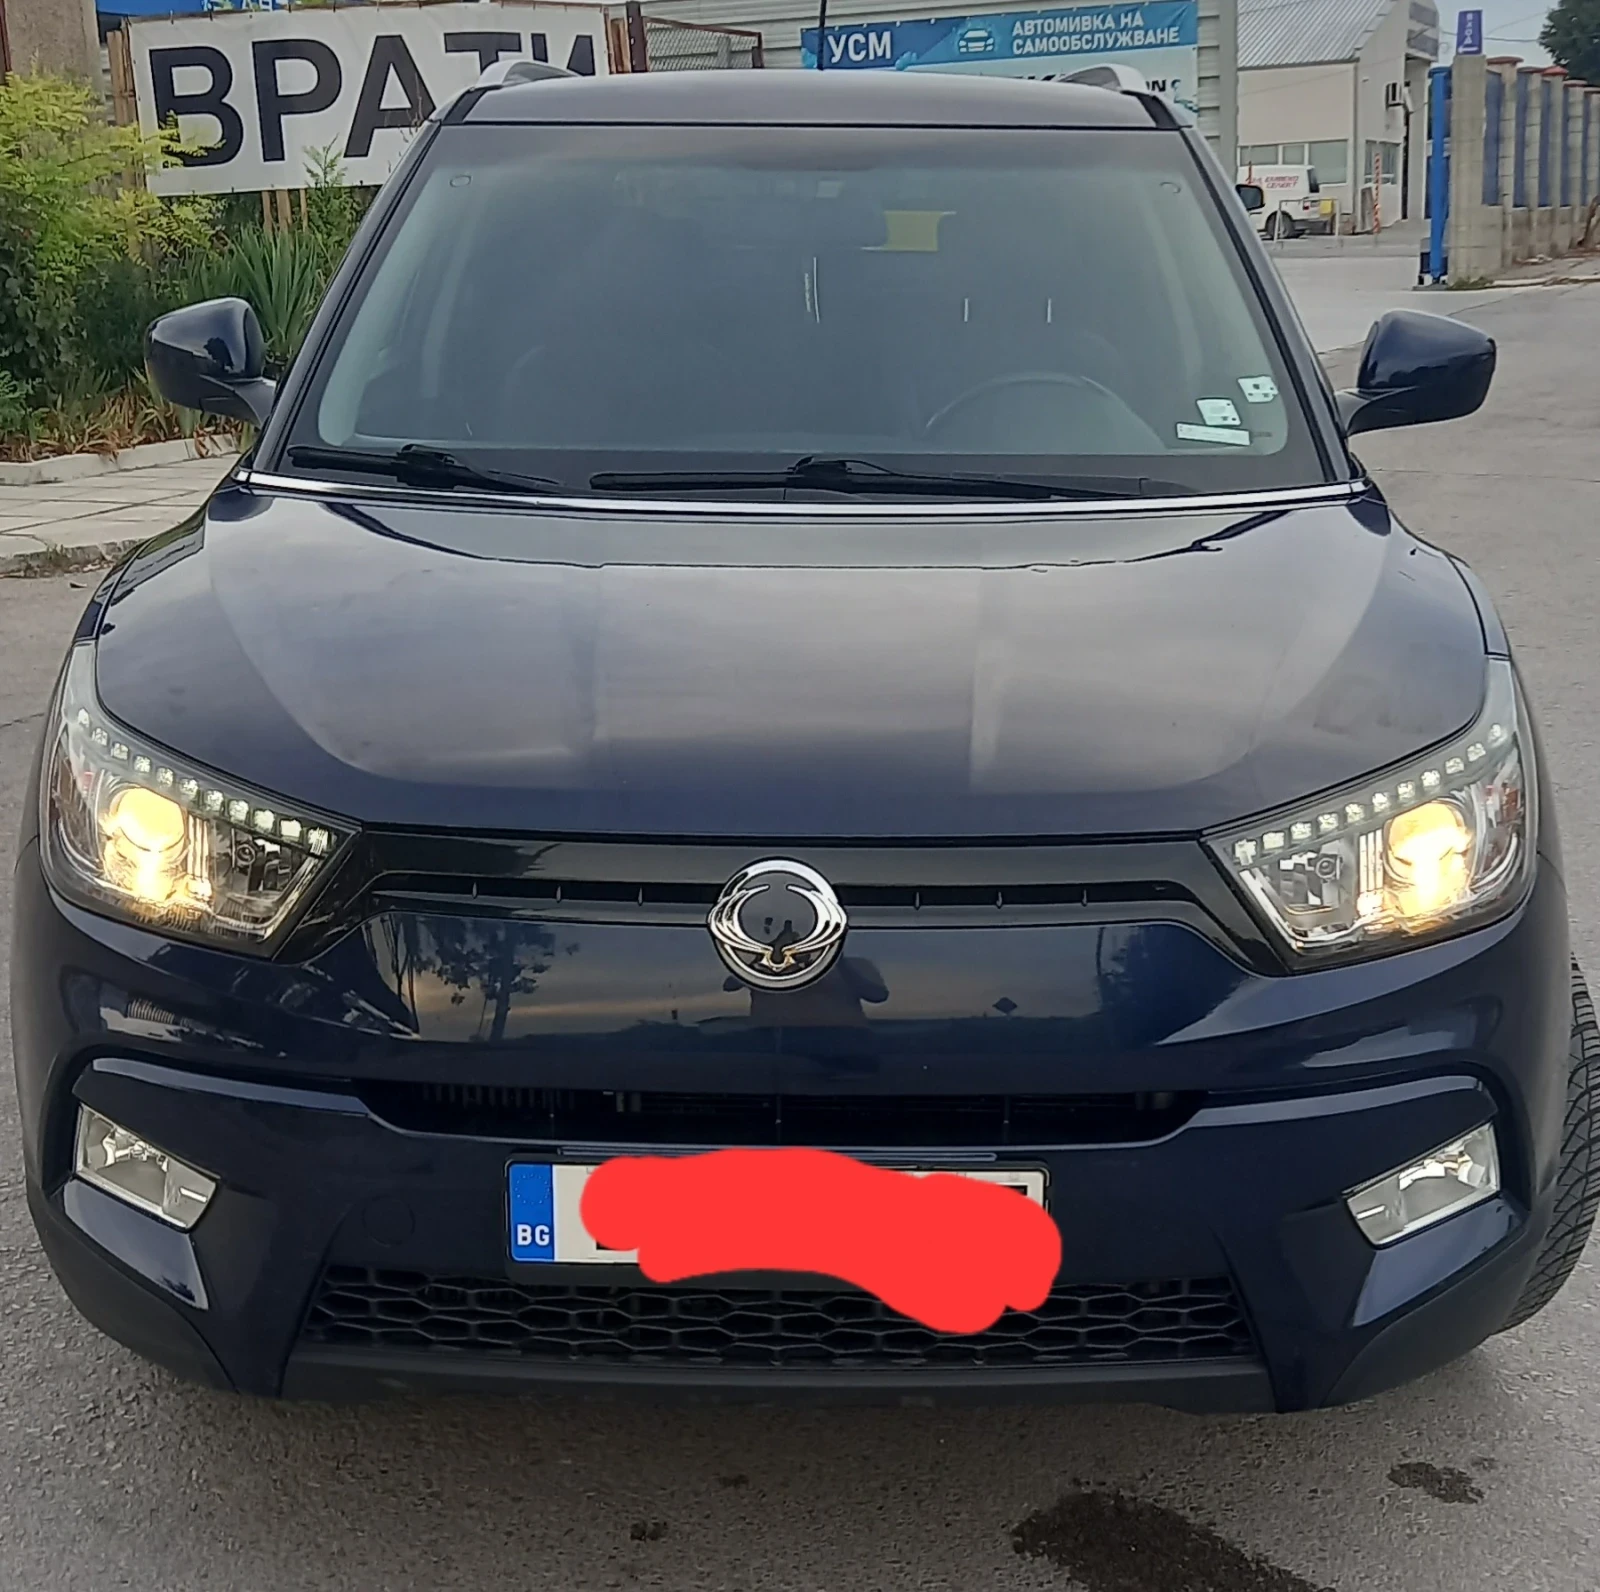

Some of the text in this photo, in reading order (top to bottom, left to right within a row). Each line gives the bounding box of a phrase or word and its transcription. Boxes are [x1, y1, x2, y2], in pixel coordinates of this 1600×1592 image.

[1012, 11, 1144, 37] АВТОМИВКА НА
[827, 30, 892, 64] УСМ
[1012, 26, 1180, 55] САМООБСЛУЖВАНЕ
[516, 1223, 551, 1247] BG
